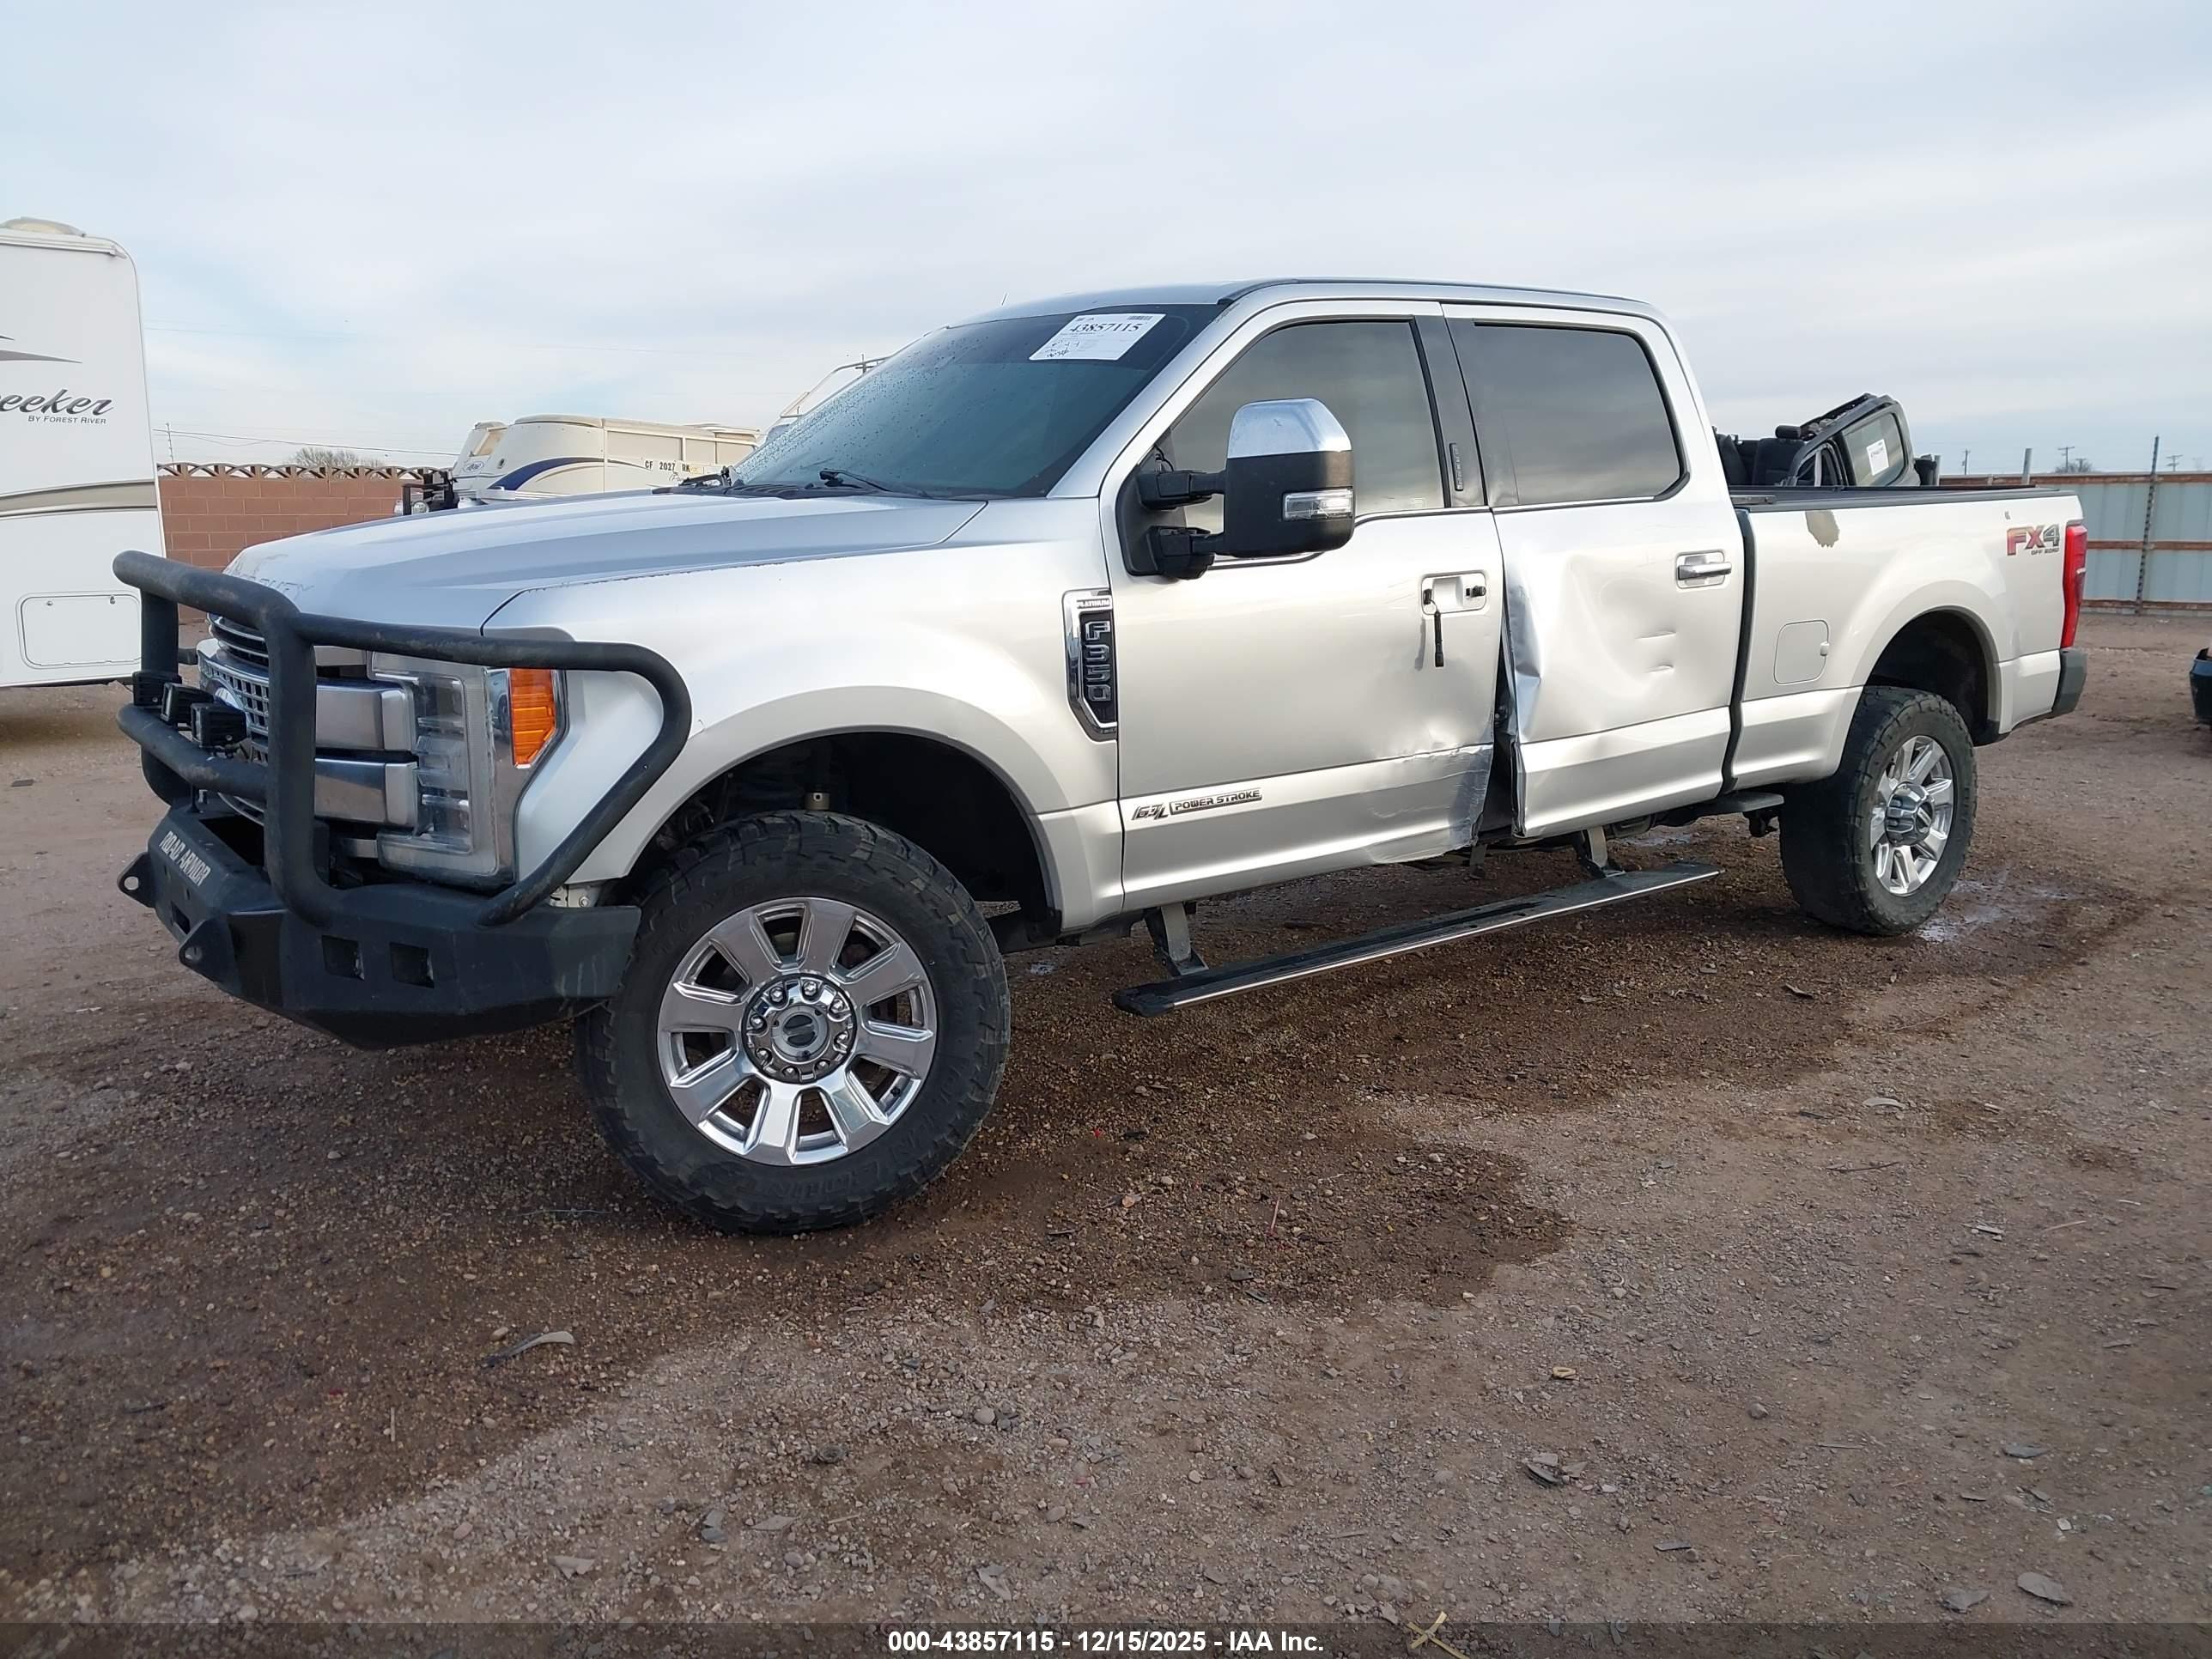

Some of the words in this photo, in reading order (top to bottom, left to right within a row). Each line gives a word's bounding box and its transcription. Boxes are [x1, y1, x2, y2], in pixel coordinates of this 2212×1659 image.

[1069, 322, 1143, 332] 43857115
[0, 389, 113, 416] eeker
[645, 460, 653, 469] CF
[659, 461, 675, 471] 2027
[2007, 524, 2060, 556] FX4
[1175, 798, 1214, 811] POWER
[1217, 790, 1261, 804] STROKE
[159, 830, 185, 861] ROAD
[177, 848, 211, 887] ARMOR
